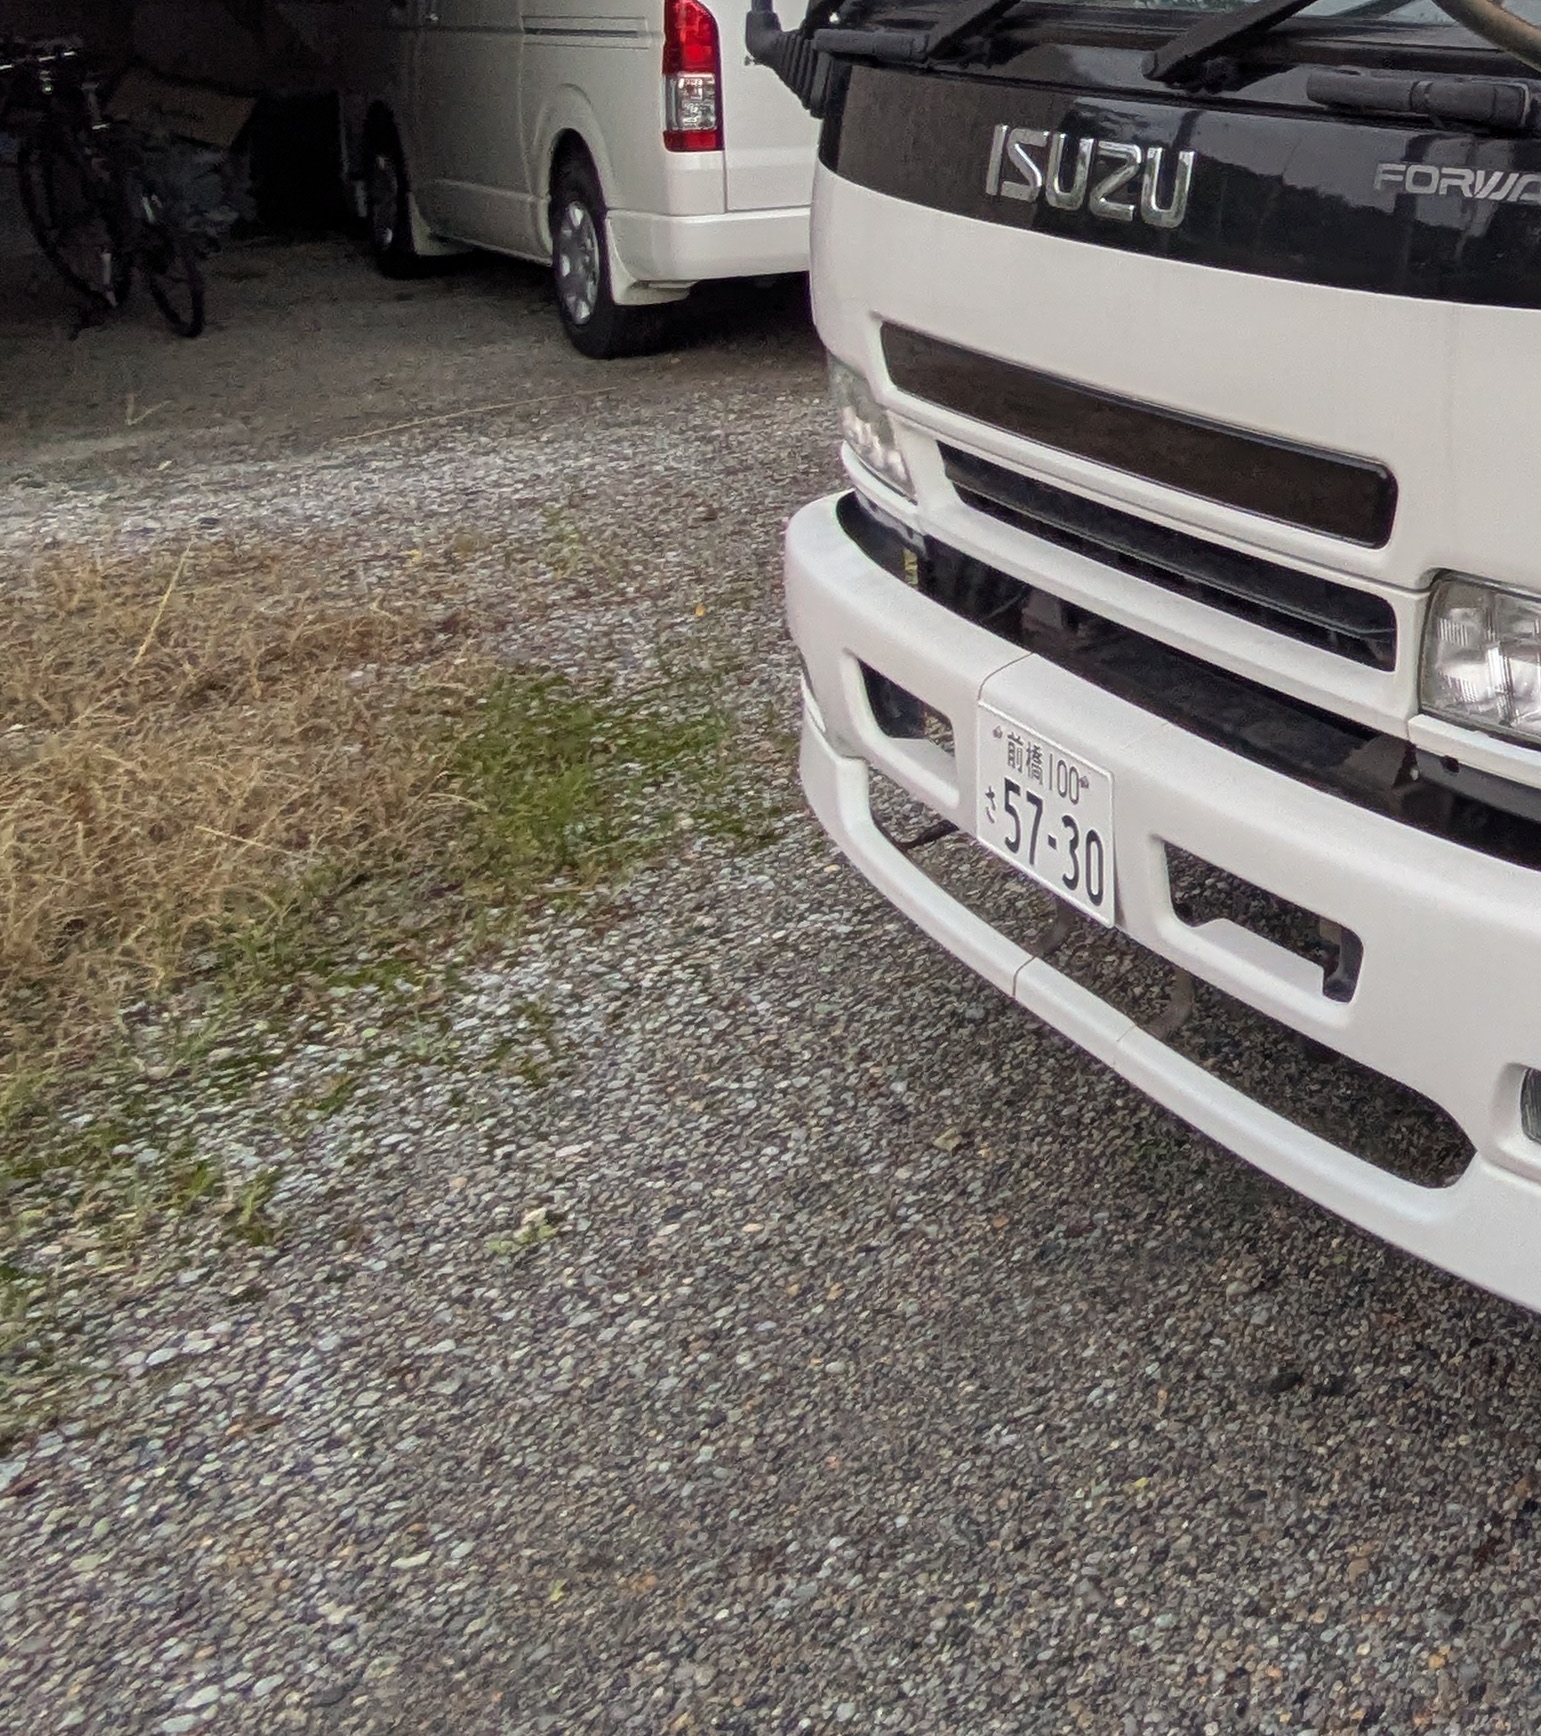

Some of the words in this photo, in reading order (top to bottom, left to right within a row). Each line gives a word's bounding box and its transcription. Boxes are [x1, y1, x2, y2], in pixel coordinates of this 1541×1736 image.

[985, 123, 1196, 229] ISUZU
[1007, 731, 1044, 786] 前橋
[1048, 752, 1080, 806] 100
[984, 785, 997, 825] さ
[1003, 776, 1105, 907] 57-30
